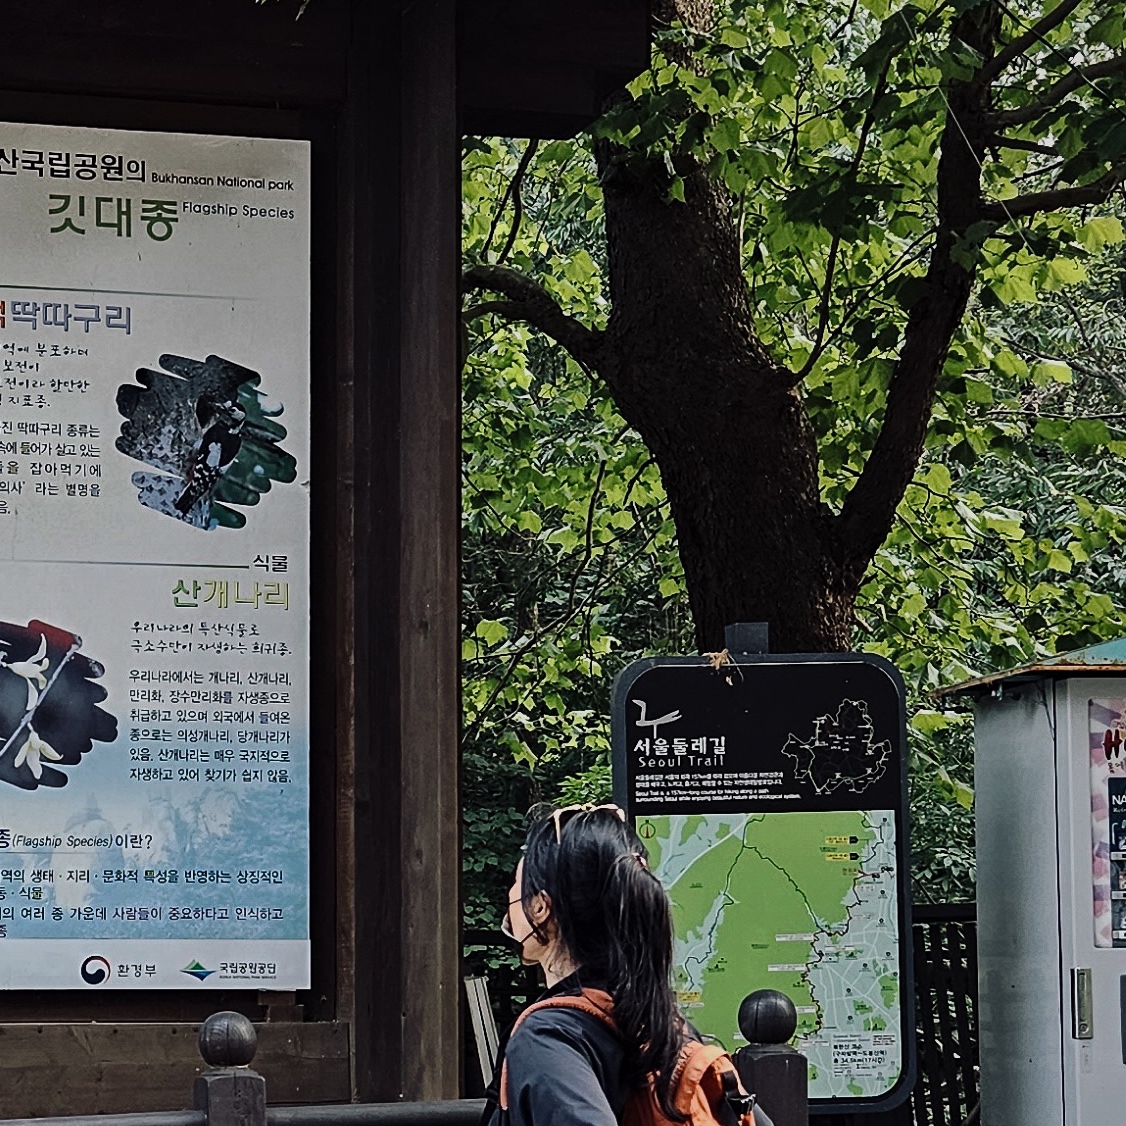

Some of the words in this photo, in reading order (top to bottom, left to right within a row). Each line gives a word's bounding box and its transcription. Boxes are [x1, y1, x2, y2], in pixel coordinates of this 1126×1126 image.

[151, 172, 214, 187] Bukhansan
[217, 175, 266, 189] National
[268, 178, 294, 192] park
[48, 193, 179, 242] 깃대종
[182, 201, 238, 218] Flagship
[242, 204, 295, 220] Species
[3, 359, 39, 373] 보전이
[8, 394, 51, 409] 지표종.
[17, 422, 62, 436] 딱따구리
[66, 424, 101, 438] 종류는
[20, 441, 52, 455] 들어가
[56, 443, 77, 456] 살고
[79, 444, 101, 457] 있는
[35, 482, 59, 495] 라는
[66, 484, 101, 497] 별명을
[253, 554, 288, 573] 식물
[171, 579, 289, 611] 산개나리
[131, 621, 193, 635] 우리나라의
[197, 642, 248, 655] 자생하는
[129, 669, 204, 684] 우리나라에서는
[169, 690, 233, 705] 장수만리화를
[238, 691, 291, 705] 자생종으로
[130, 709, 172, 723] 취급하고
[176, 710, 208, 723] 있으며
[212, 711, 255, 724] 외국에서
[259, 712, 291, 725] 들여온
[130, 728, 173, 742] 종으로는
[238, 730, 291, 744] 당개나리가
[633, 736, 726, 756] 서울둘레길
[130, 748, 154, 762] 있음.
[157, 749, 211, 763] 산개나리는
[214, 750, 235, 763] 매우
[239, 750, 291, 763] 국지적으로
[638, 756, 681, 768] Seoul
[688, 755, 724, 767] Trail
[130, 767, 174, 782] 자생하고
[177, 768, 200, 782] 있어
[204, 769, 236, 783] 찾기가
[241, 769, 263, 783] 쉽지
[267, 769, 292, 784] 않음.
[30, 869, 54, 883] 생태
[66, 869, 90, 883] 지리
[102, 869, 138, 884] 문화적
[144, 869, 179, 884] 특성을
[184, 869, 232, 884] 반영하는
[236, 870, 283, 884] 상징적인
[20, 907, 45, 921] 여러
[51, 907, 63, 921] 종
[70, 907, 107, 921] 가운데
[112, 907, 163, 921] 사람들이
[168, 907, 230, 921] 중요하다고
[235, 907, 284, 921] 인식하고
[117, 964, 157, 978] 환경부
[219, 962, 277, 975] 국립공원공단
